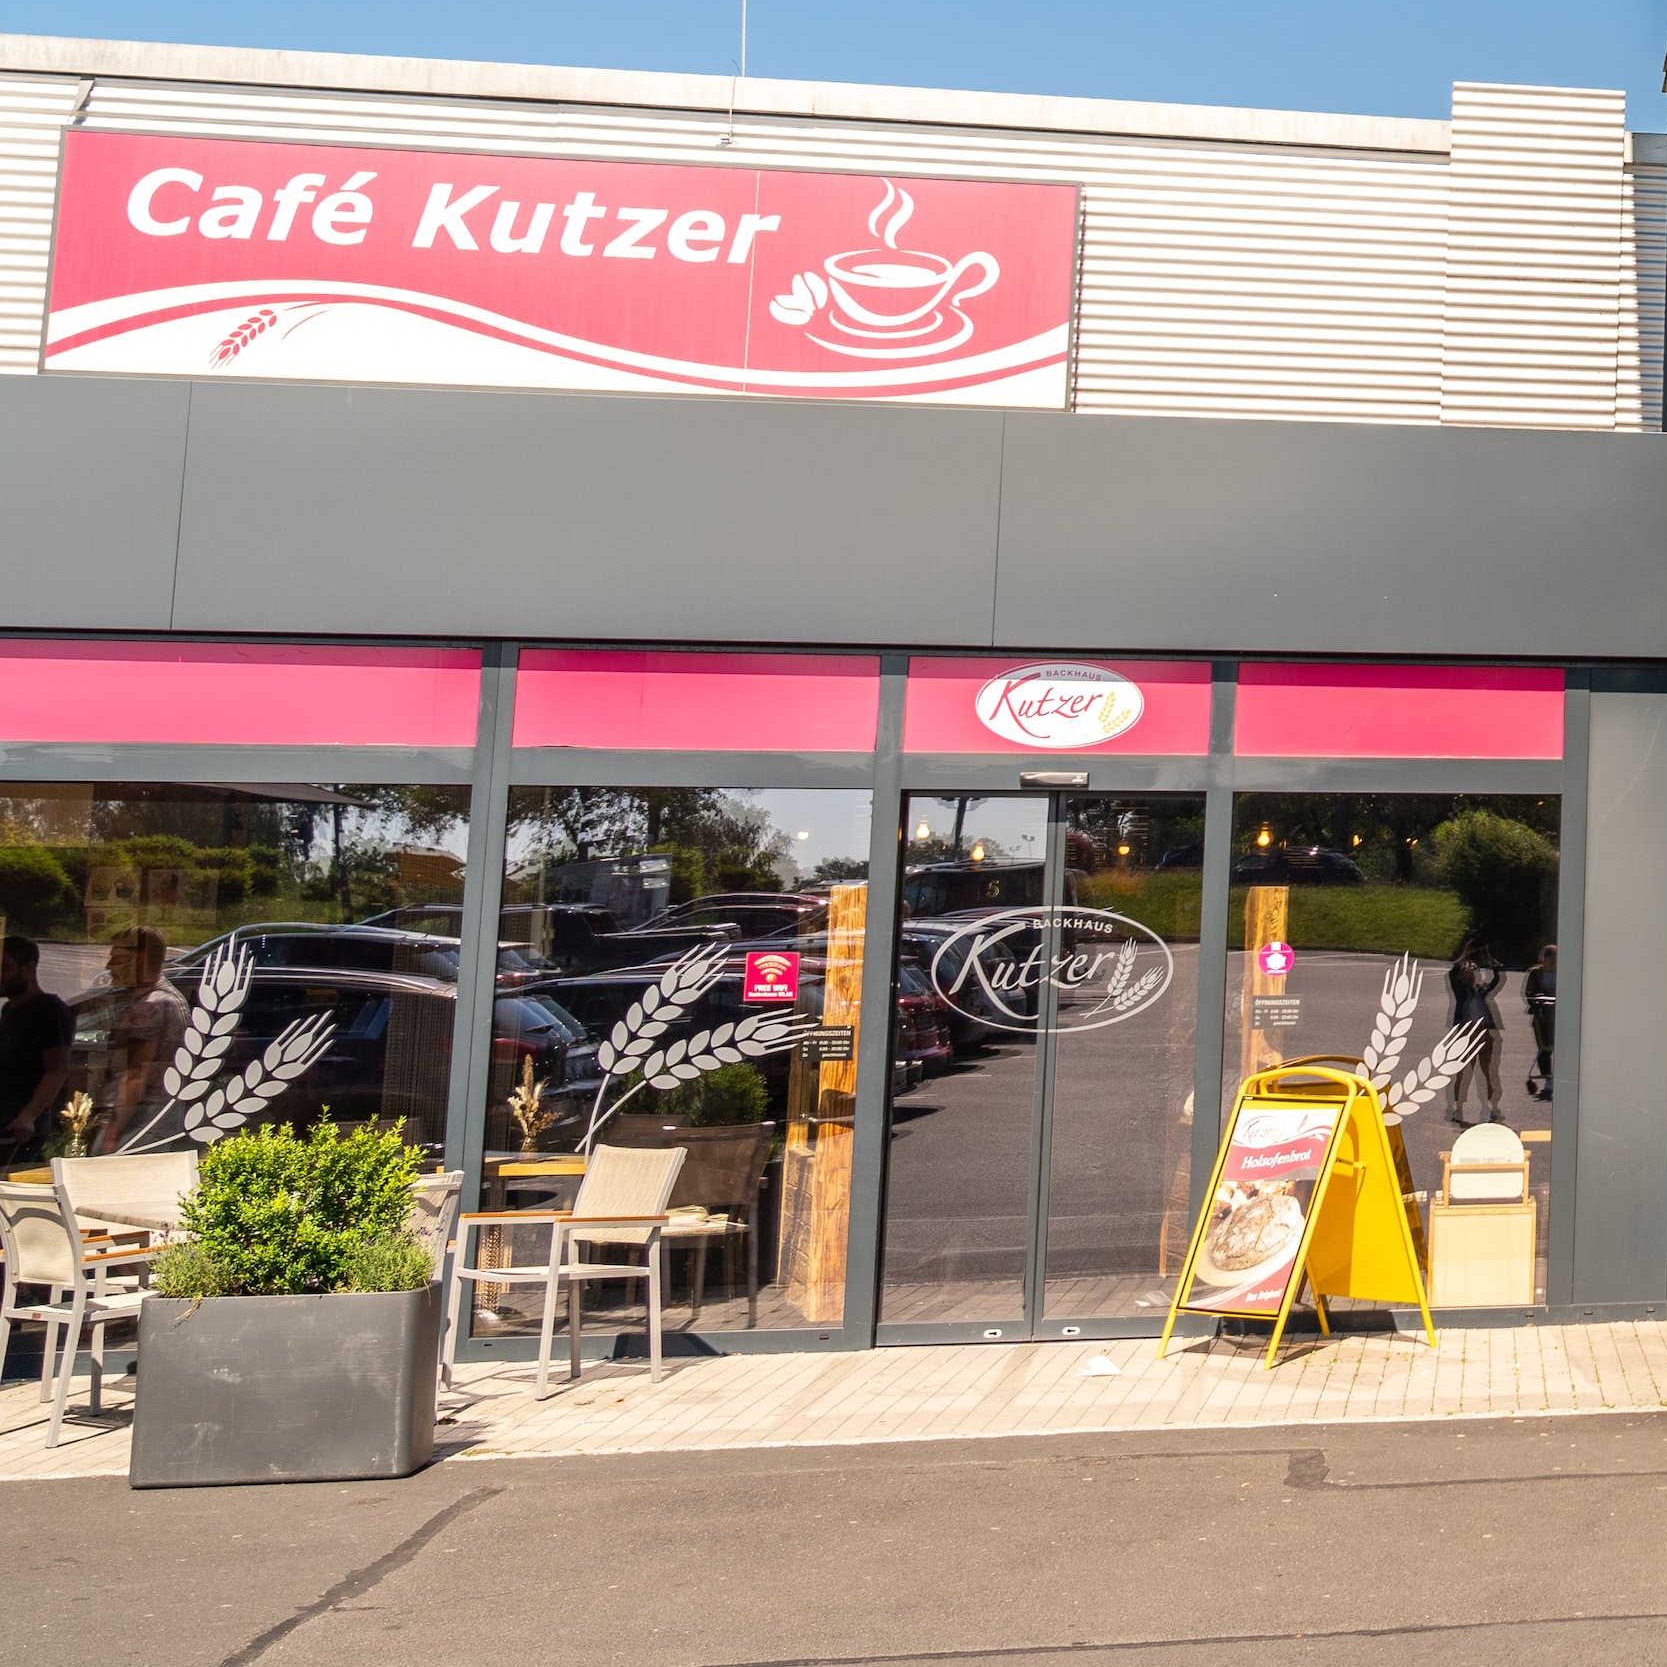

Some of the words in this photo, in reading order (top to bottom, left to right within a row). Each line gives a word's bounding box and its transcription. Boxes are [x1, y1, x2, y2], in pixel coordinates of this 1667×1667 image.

[125, 167, 381, 246] Café
[410, 182, 782, 264] Kutzer
[1046, 669, 1102, 681] BACKHAUS
[989, 672, 1103, 739] Kutzer
[1033, 917, 1114, 934] BACKHAUS
[949, 922, 1116, 1020] Kutzer
[1241, 1148, 1313, 1170] Holzofenbrot
